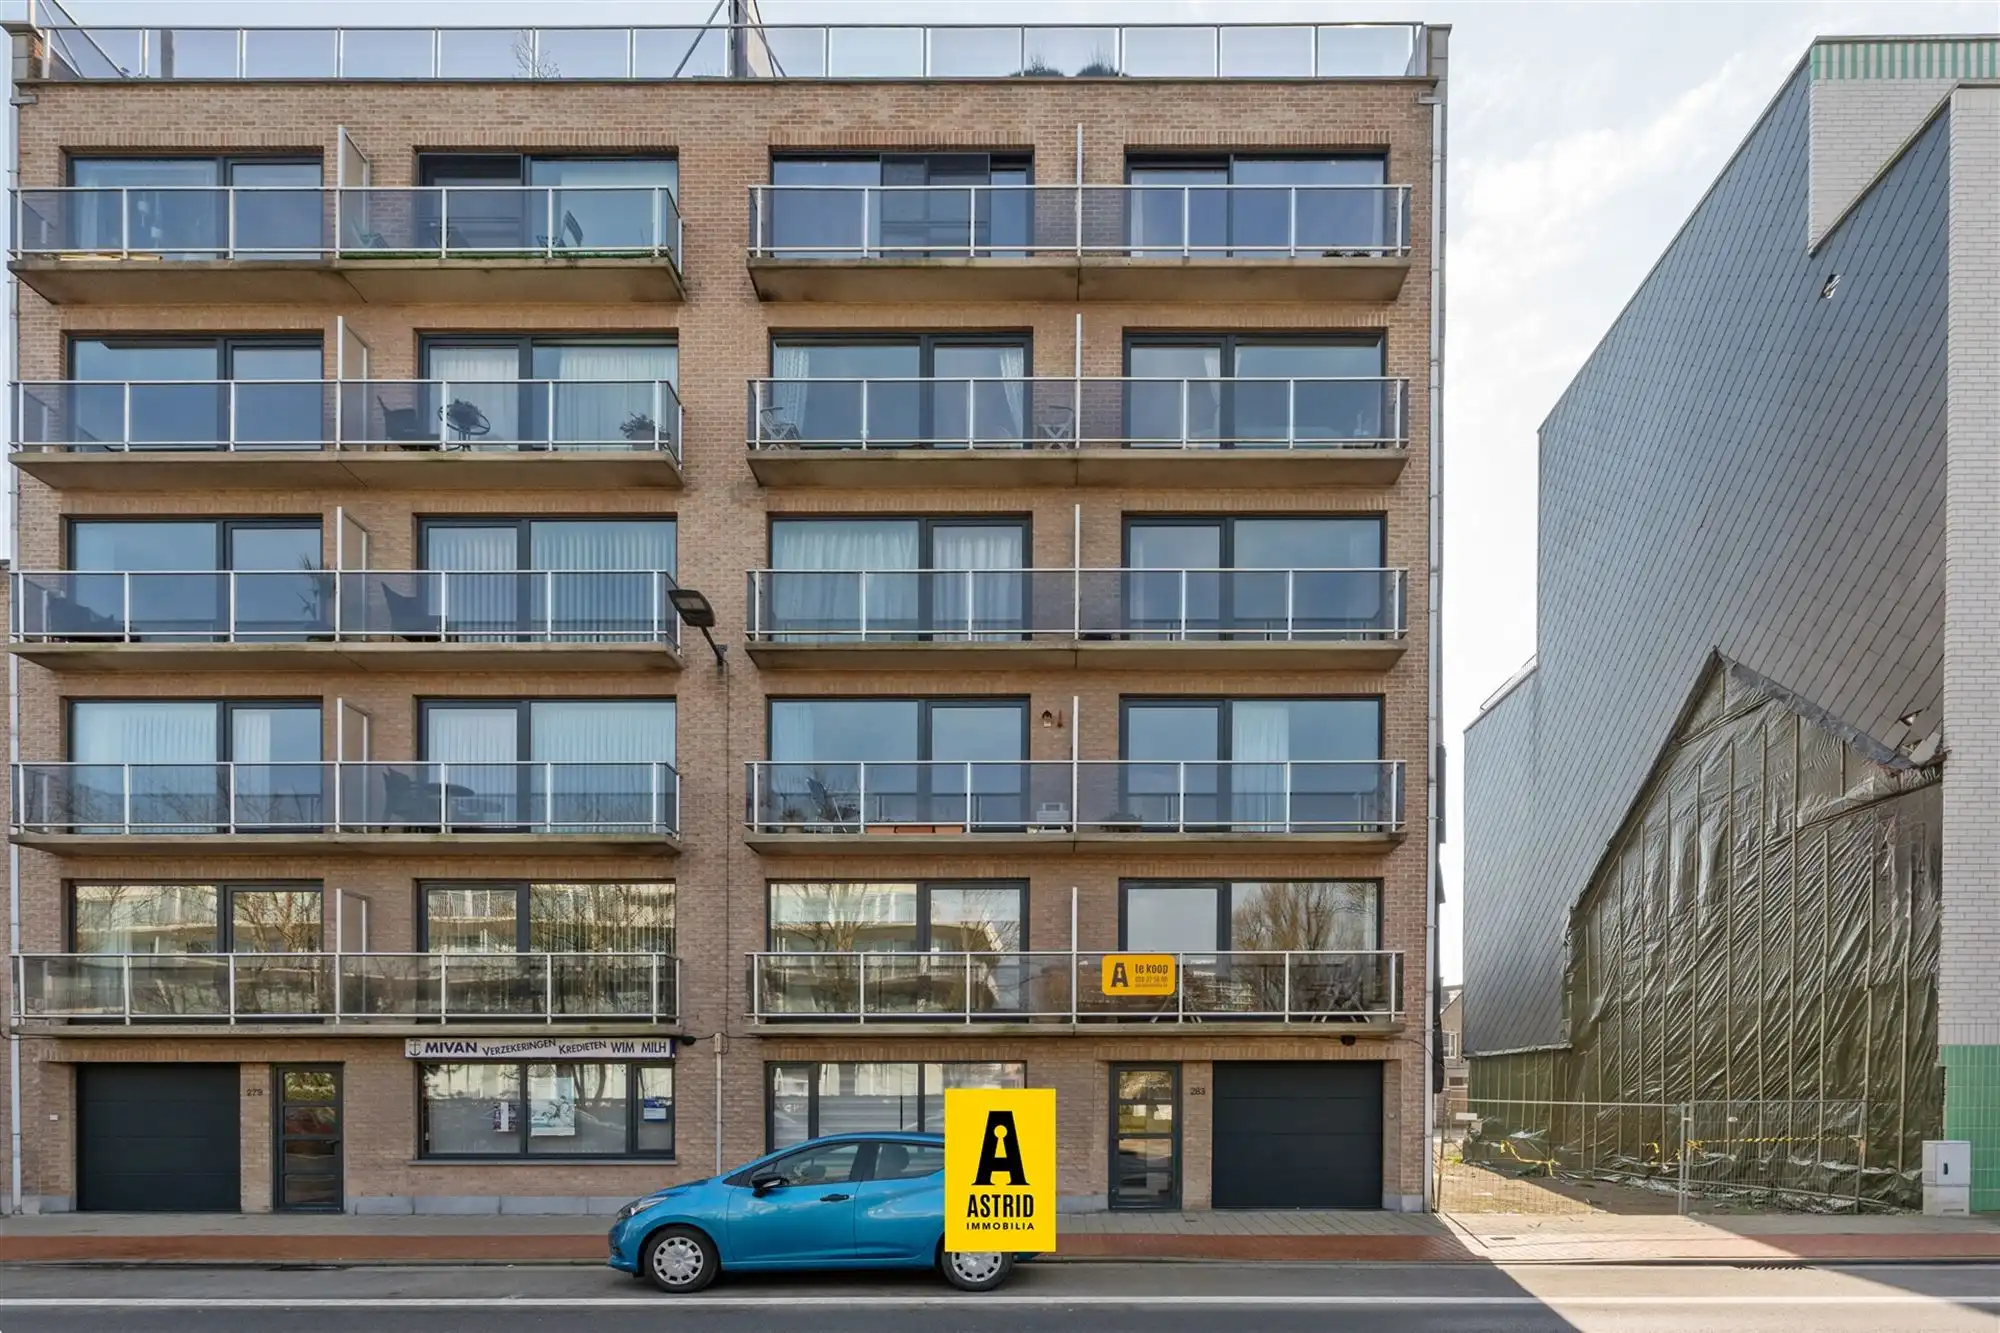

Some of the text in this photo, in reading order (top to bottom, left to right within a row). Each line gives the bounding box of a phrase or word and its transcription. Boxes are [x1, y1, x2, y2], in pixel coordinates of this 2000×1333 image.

[1146, 963, 1168, 975] koop
[425, 1041, 478, 1054] MIVAN
[482, 1037, 556, 1056] VERZEKERINGEN
[559, 1040, 607, 1055] KREDIETEN
[611, 1042, 635, 1054] WIM
[246, 1088, 263, 1097] 279
[1190, 1086, 1205, 1096] 283
